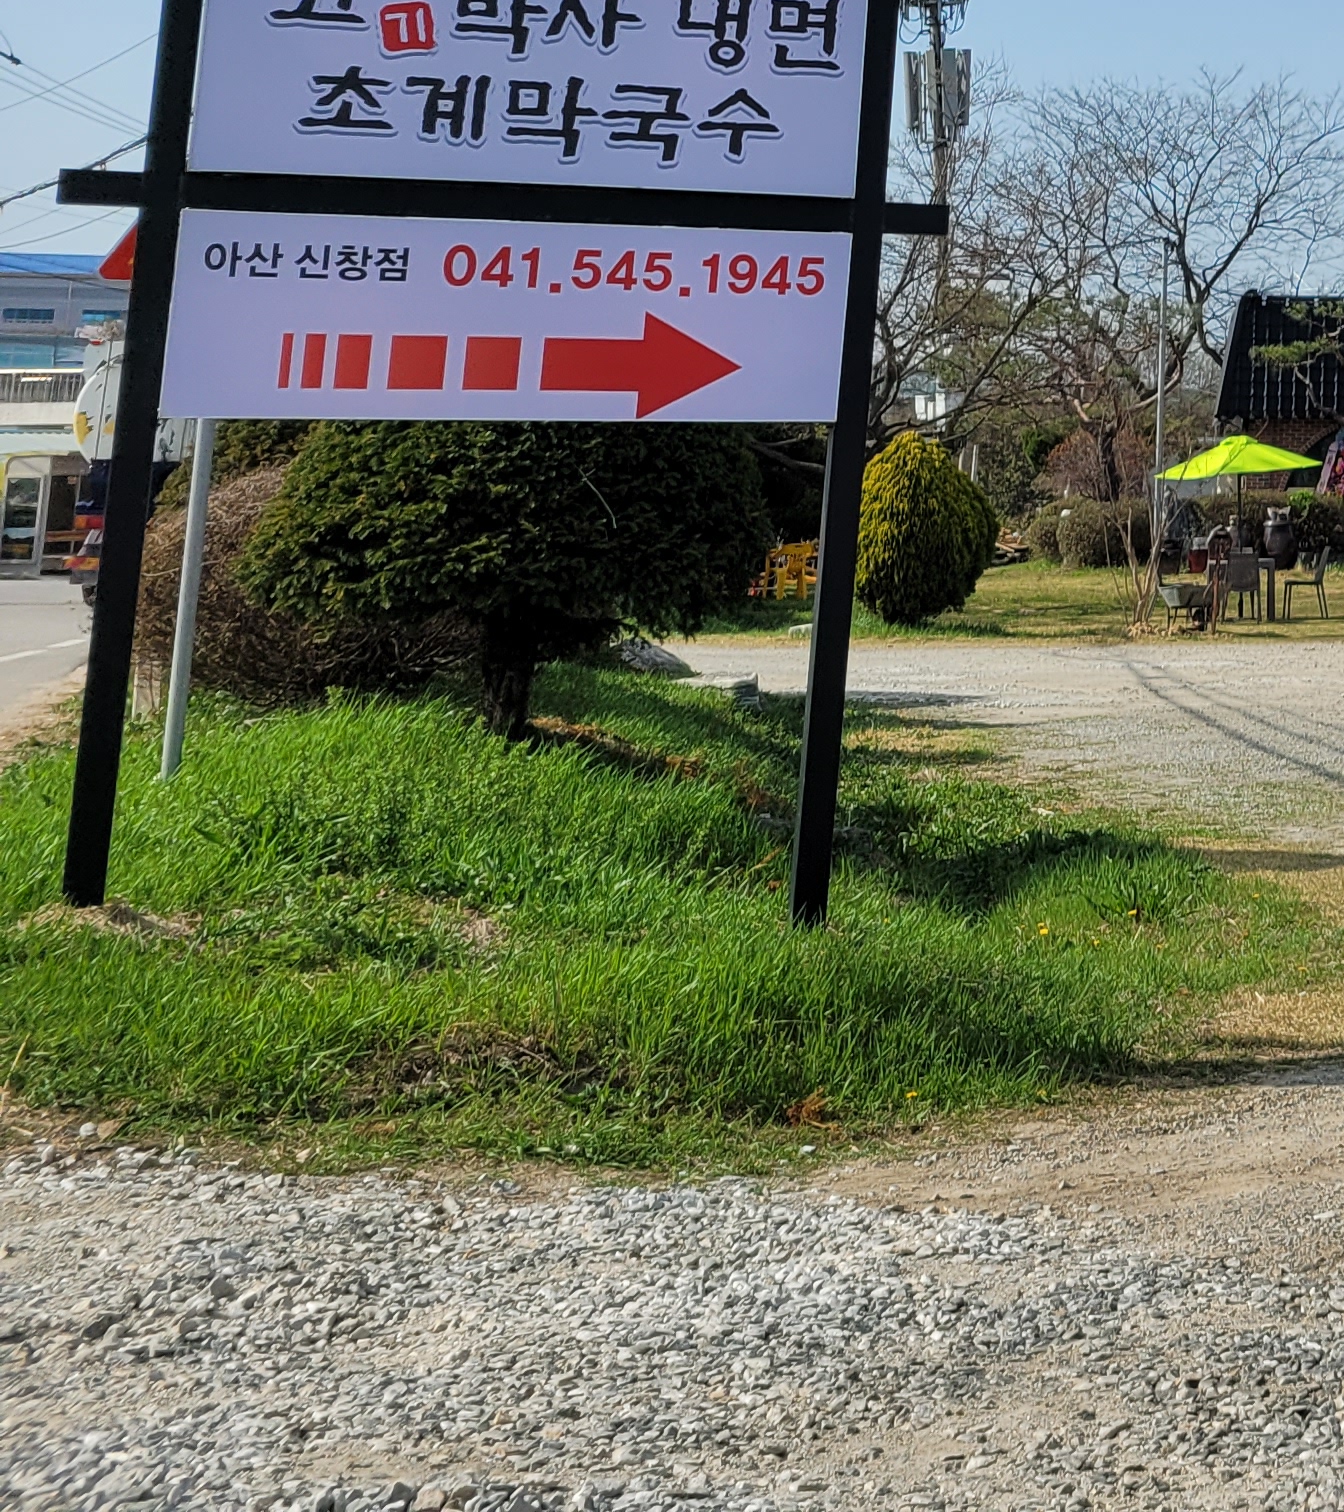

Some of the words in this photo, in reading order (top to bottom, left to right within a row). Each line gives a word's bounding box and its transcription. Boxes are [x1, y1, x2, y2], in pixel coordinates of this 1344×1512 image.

[297, 65, 781, 162] 초계막국수
[203, 241, 285, 278] 아산
[294, 243, 411, 282] 신창점
[442, 244, 826, 297] 041.545.1945
